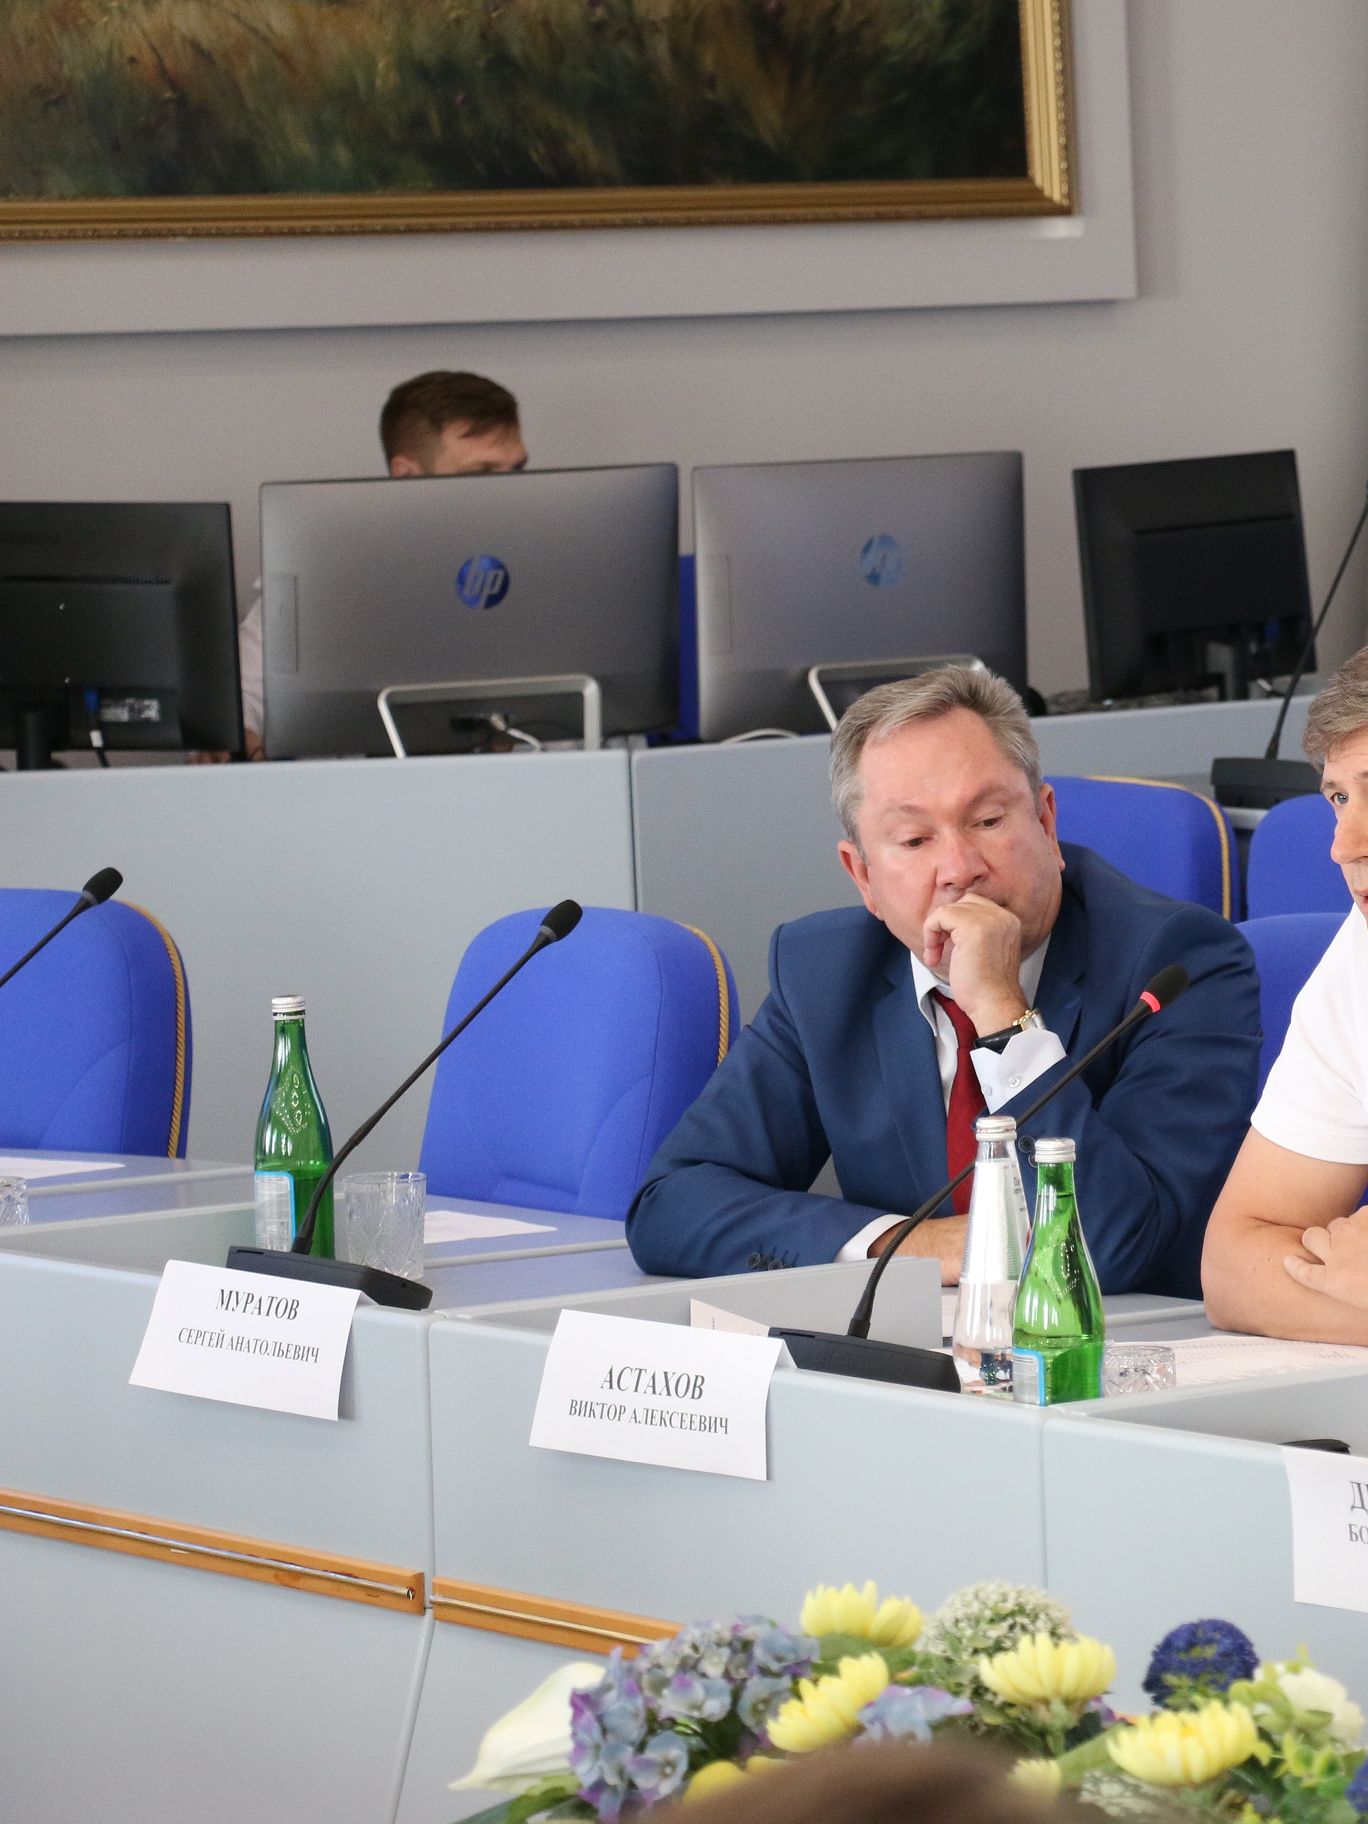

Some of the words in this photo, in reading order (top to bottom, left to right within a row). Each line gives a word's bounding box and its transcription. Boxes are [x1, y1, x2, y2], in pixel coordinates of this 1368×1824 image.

[458, 556, 507, 608] hp
[216, 1288, 299, 1321] МУРАТОВ
[178, 1327, 226, 1349] СЕРГЕЙ
[226, 1335, 319, 1363] АНАТОЛЬЕВИЧ
[600, 1365, 706, 1400] АСТАХОВ
[568, 1398, 626, 1424] ВИКТОР
[628, 1407, 729, 1435] АЛЕКСЕЕВИЧ
